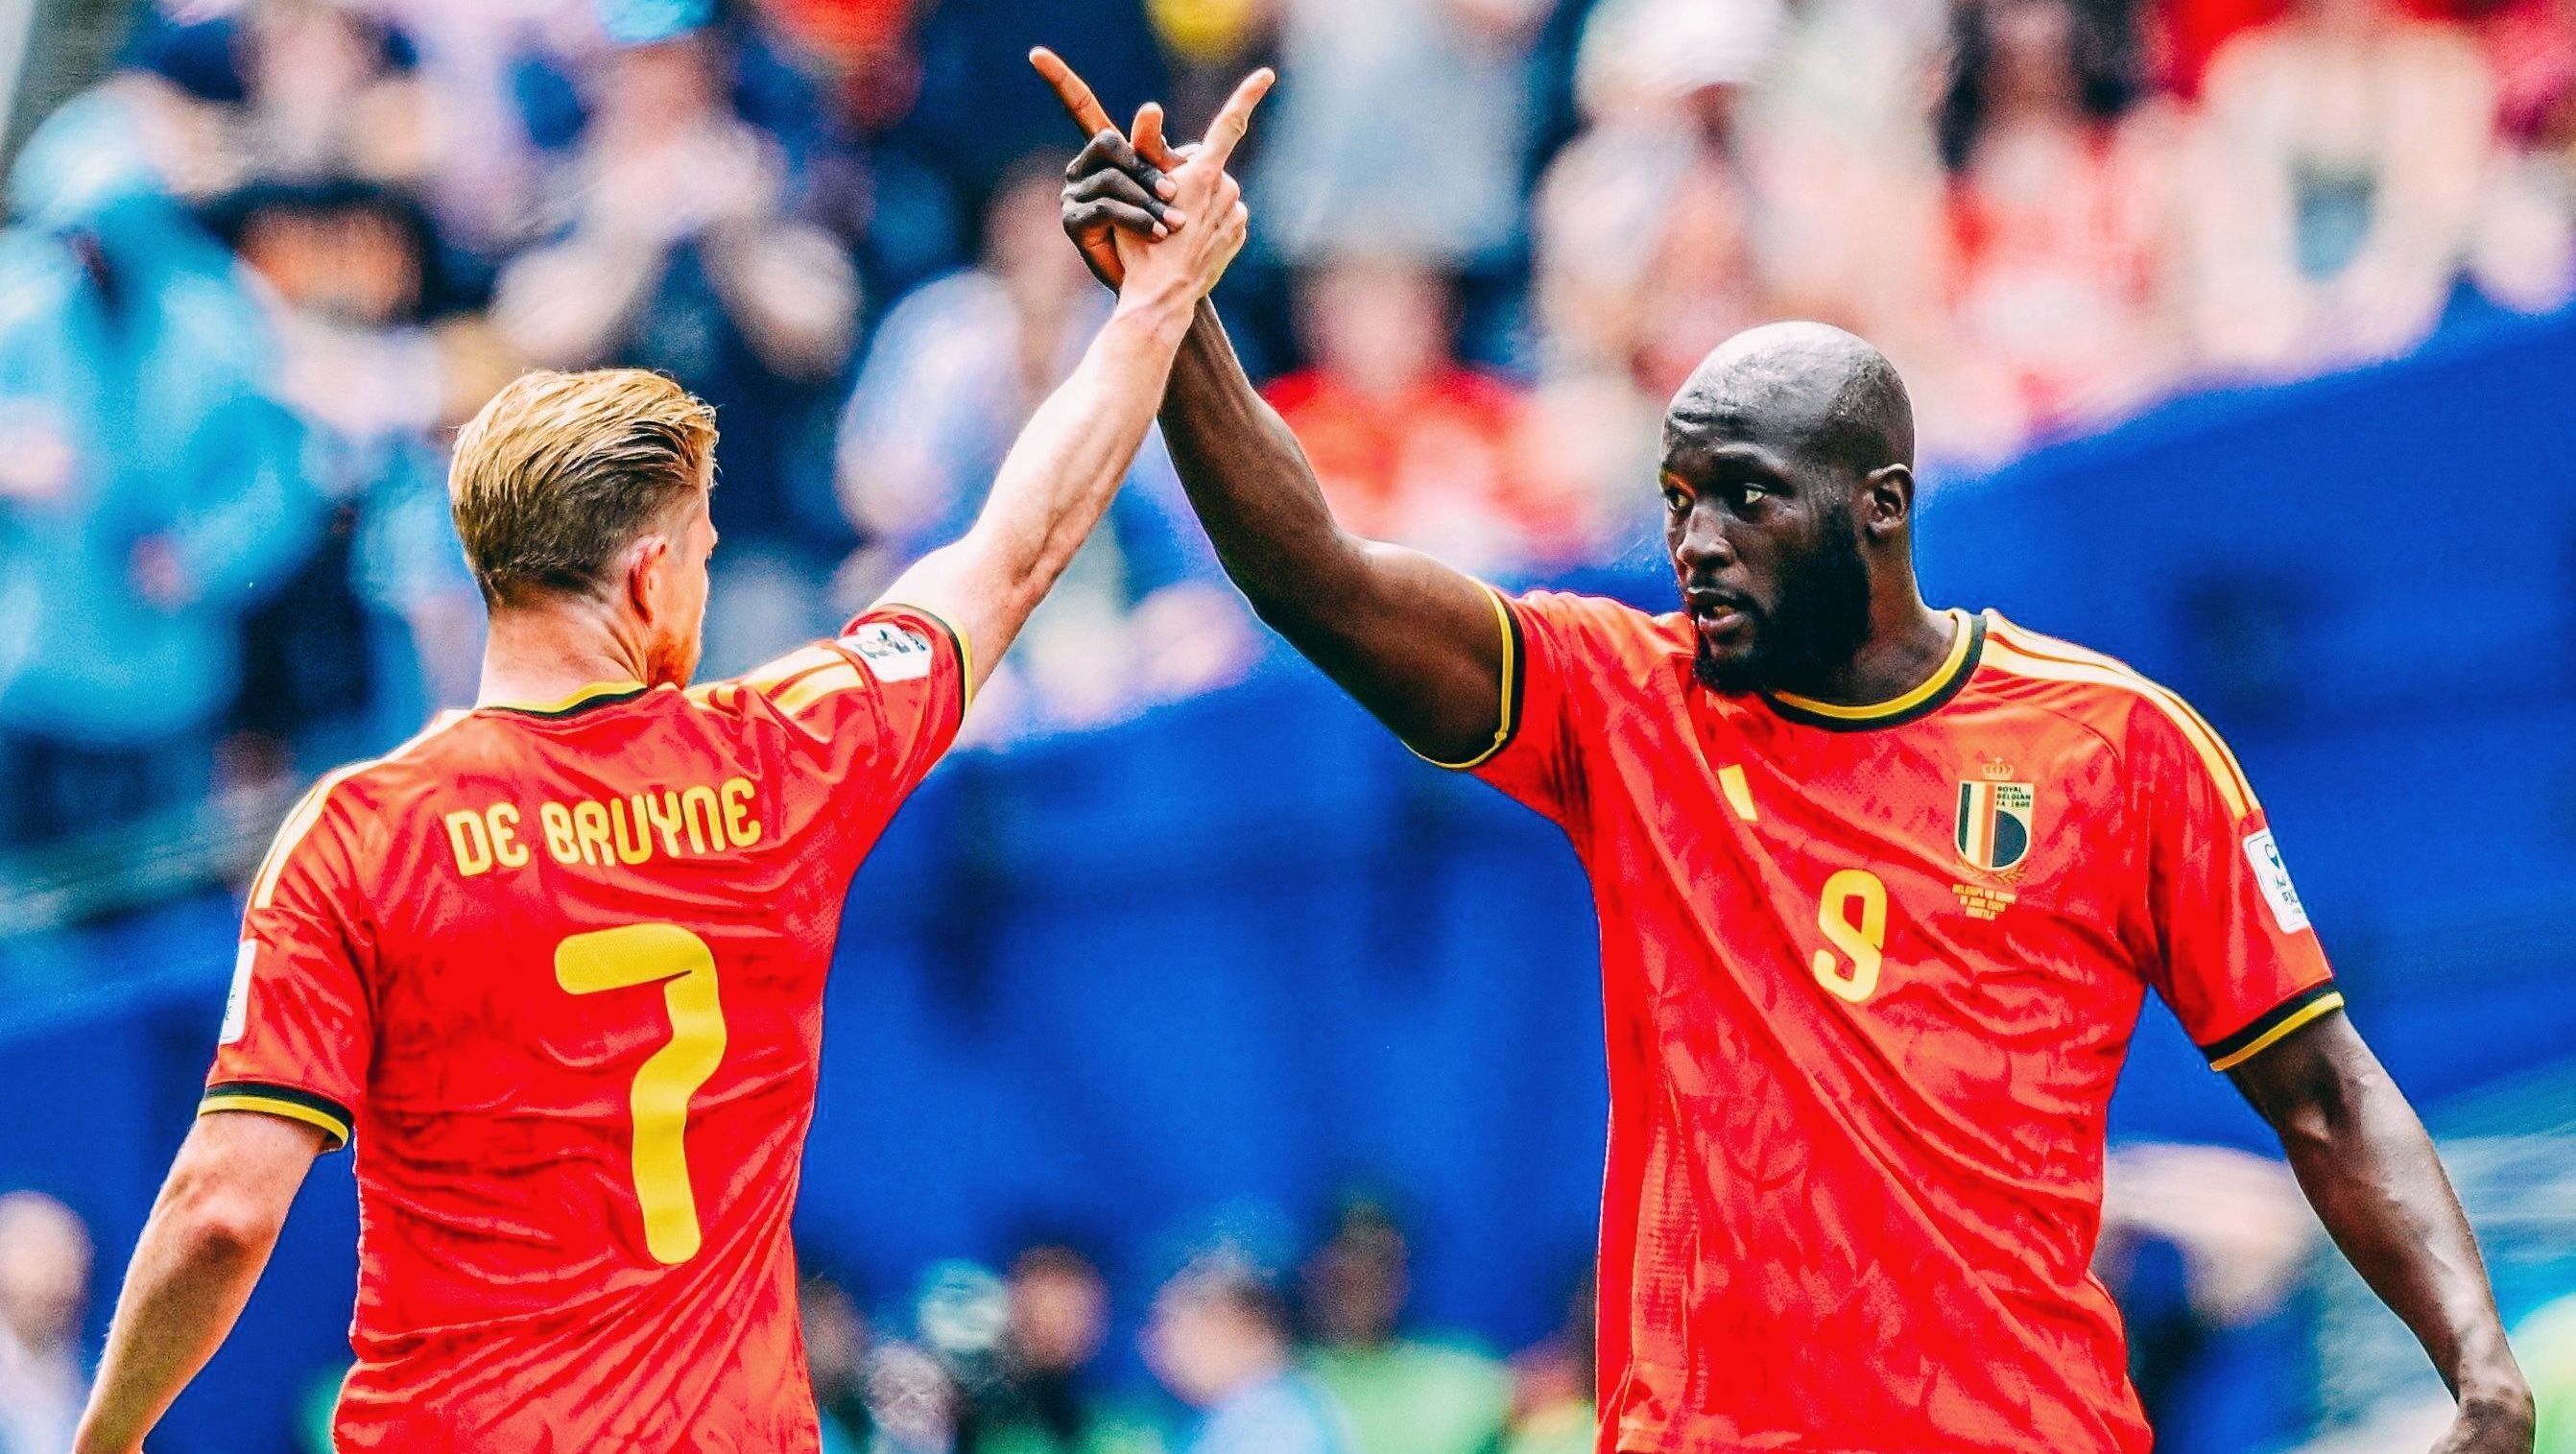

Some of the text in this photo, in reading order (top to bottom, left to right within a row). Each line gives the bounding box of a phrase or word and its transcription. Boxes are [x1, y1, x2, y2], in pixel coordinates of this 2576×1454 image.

[445, 776, 762, 877] DE BRUYNE
[1812, 869, 1888, 1003] 9
[554, 922, 727, 1265] 7
